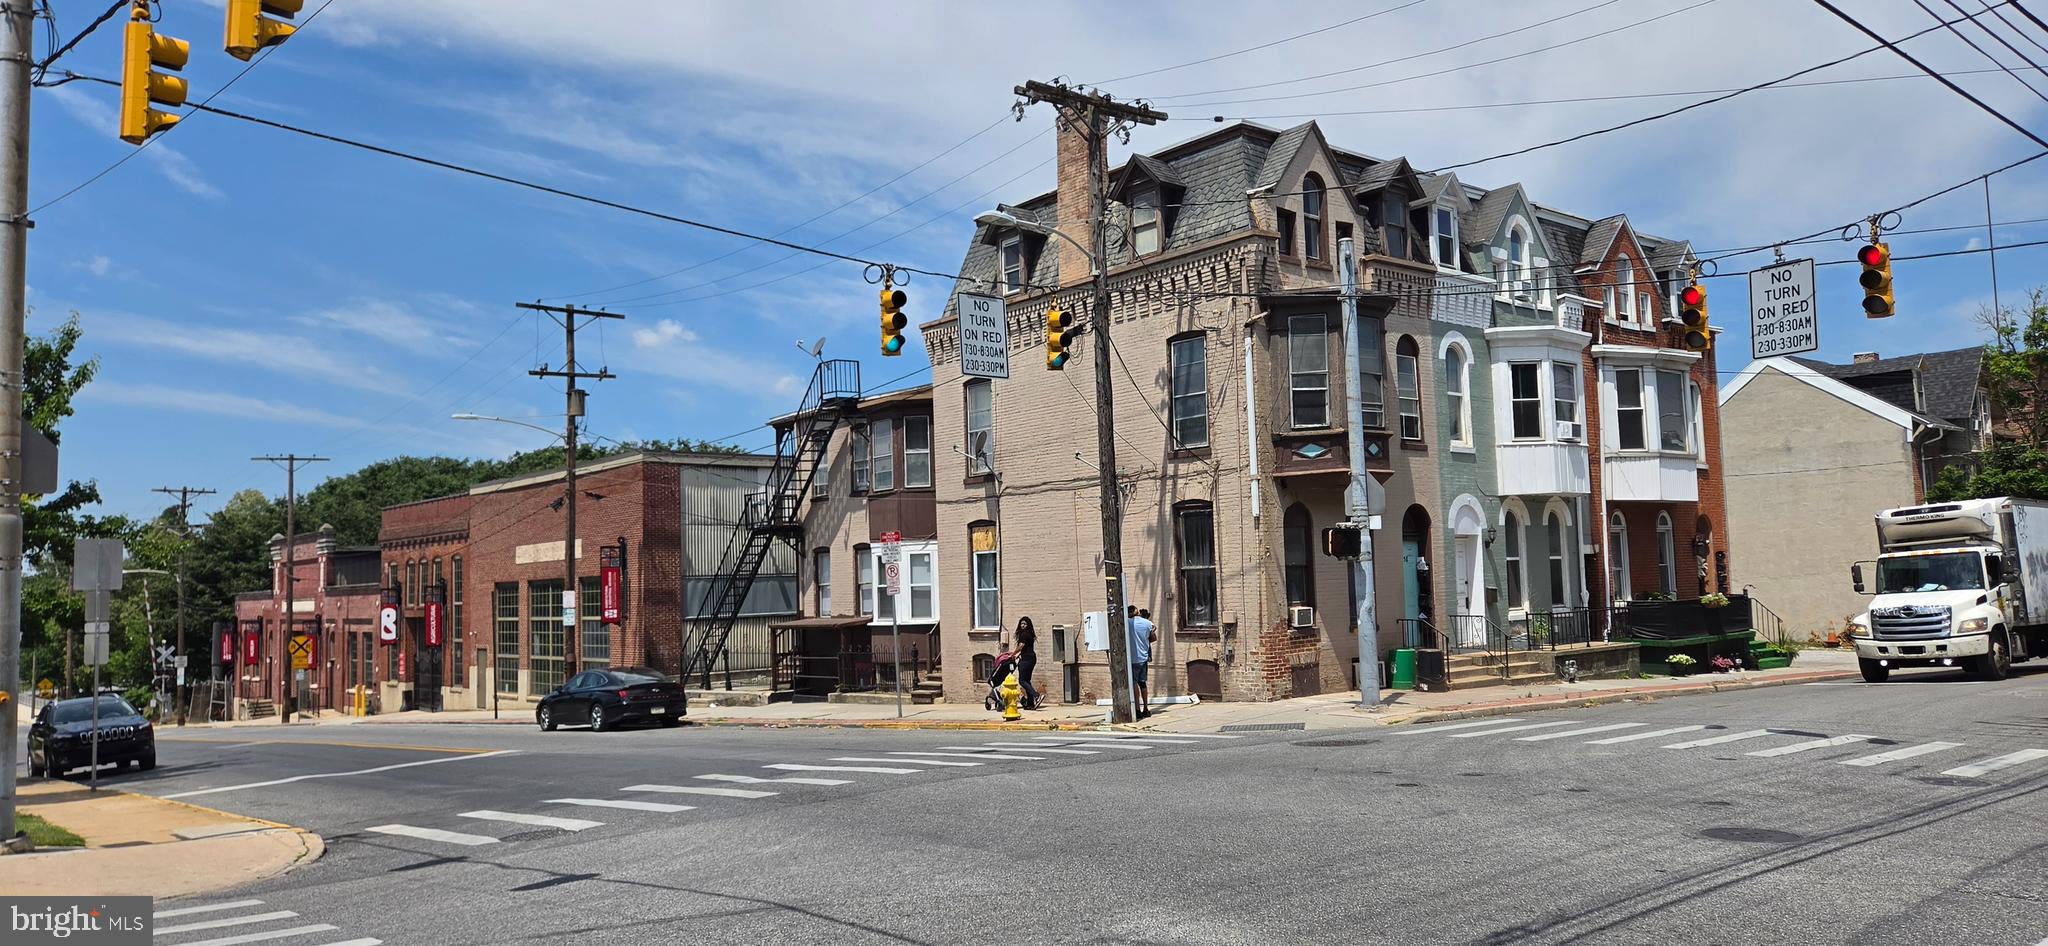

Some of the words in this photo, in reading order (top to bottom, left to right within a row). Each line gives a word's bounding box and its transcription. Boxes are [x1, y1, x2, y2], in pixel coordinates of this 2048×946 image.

[1771, 270, 1792, 284] NO
[1764, 284, 1800, 302] TURN
[974, 300, 990, 312] NO
[1757, 306, 1776, 320] ON
[1782, 300, 1809, 316] RED
[969, 314, 996, 328] TURN
[964, 328, 978, 340] ON
[982, 331, 1002, 343] RED
